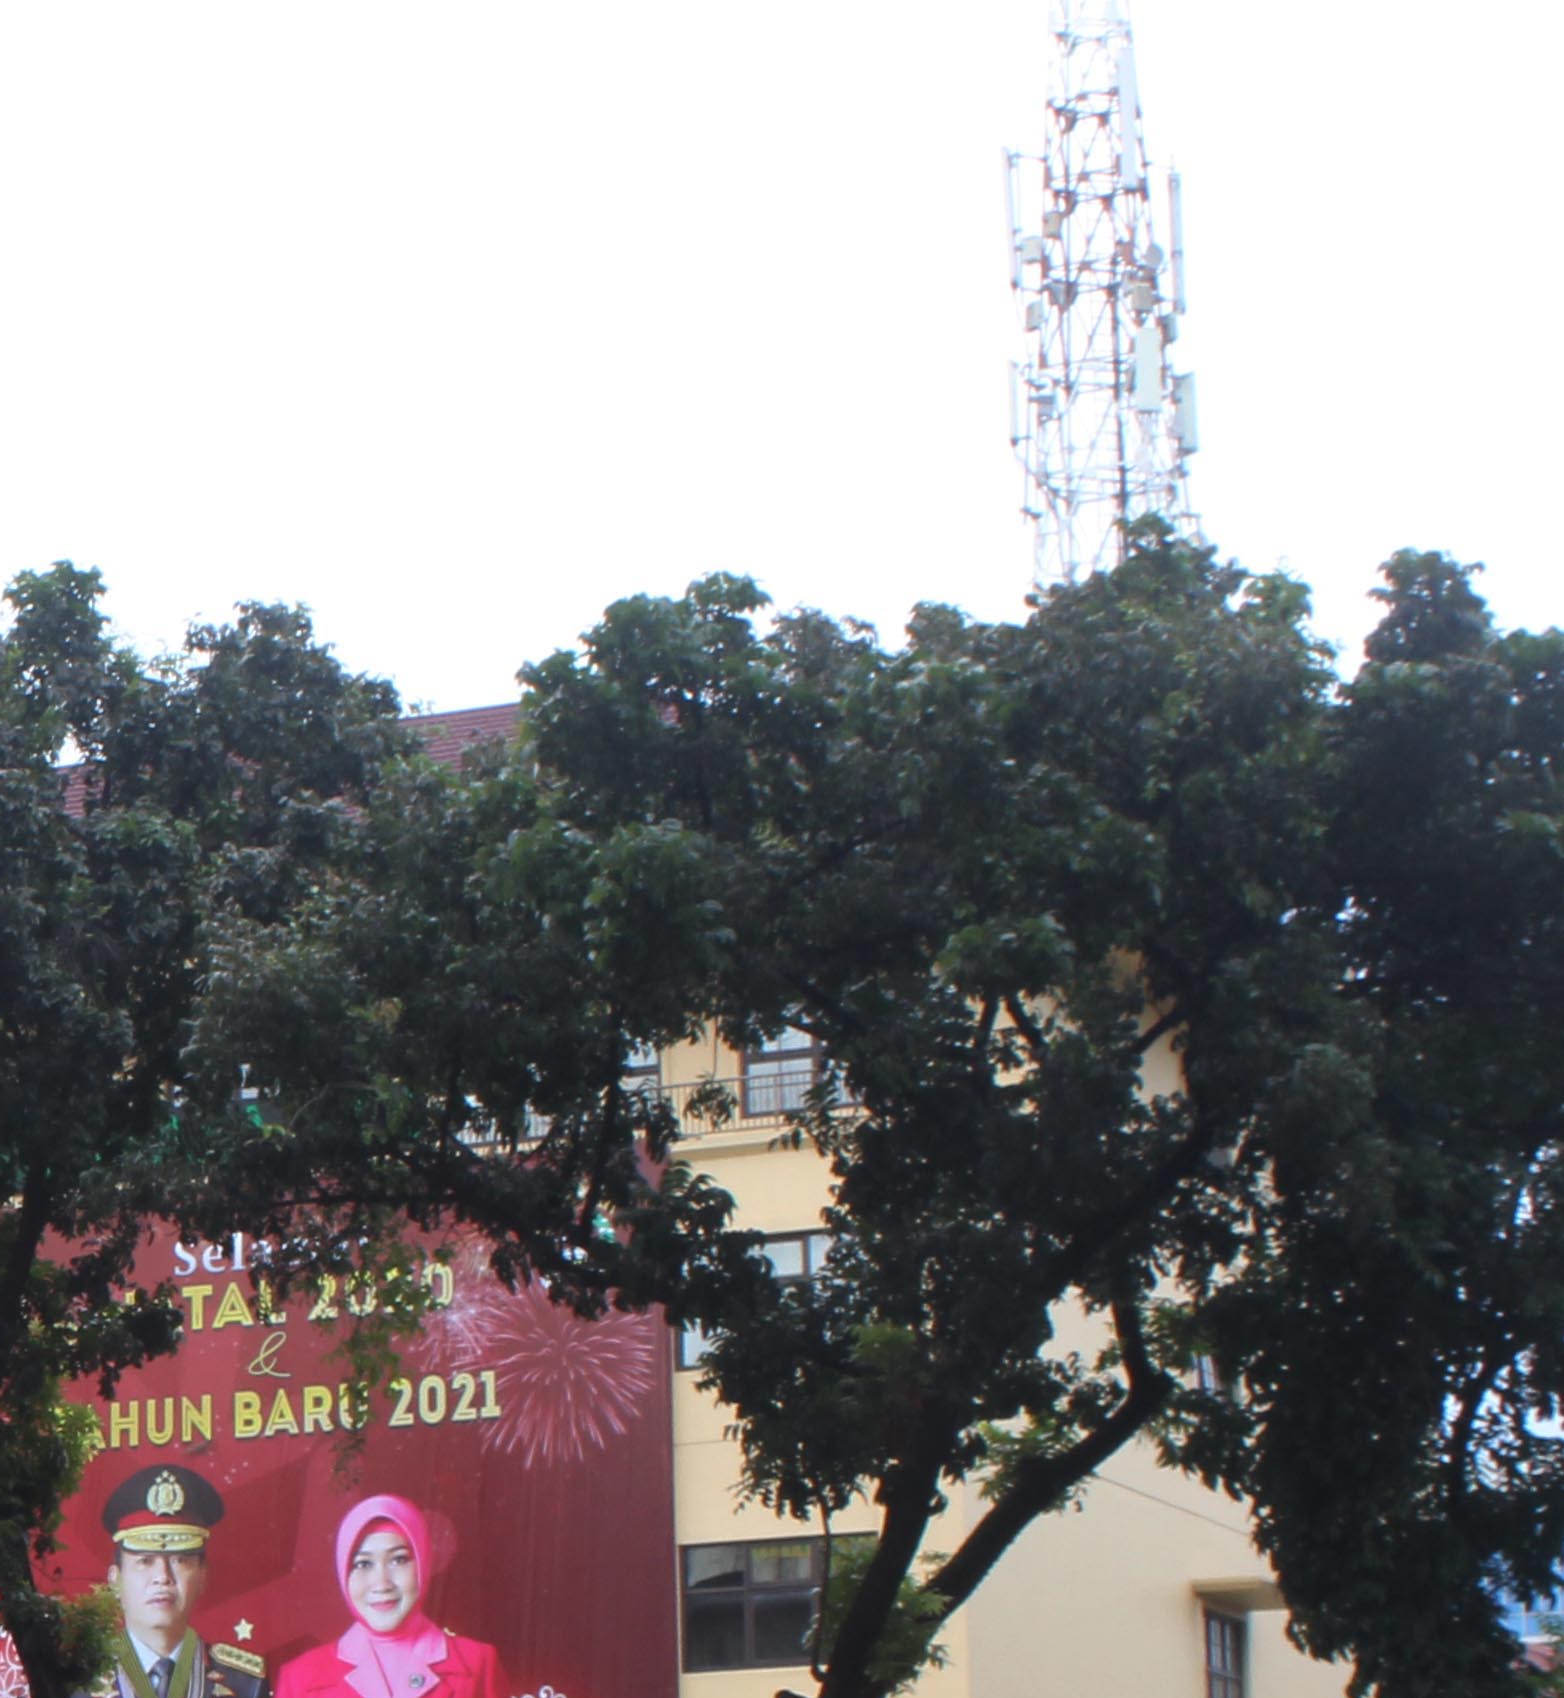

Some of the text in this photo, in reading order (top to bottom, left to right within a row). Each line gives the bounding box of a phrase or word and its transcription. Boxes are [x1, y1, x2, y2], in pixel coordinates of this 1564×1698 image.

[308, 1262, 454, 1320] 200
[248, 1331, 292, 1377] &
[233, 1381, 369, 1439] BARU
[388, 1370, 503, 1427] 2021
